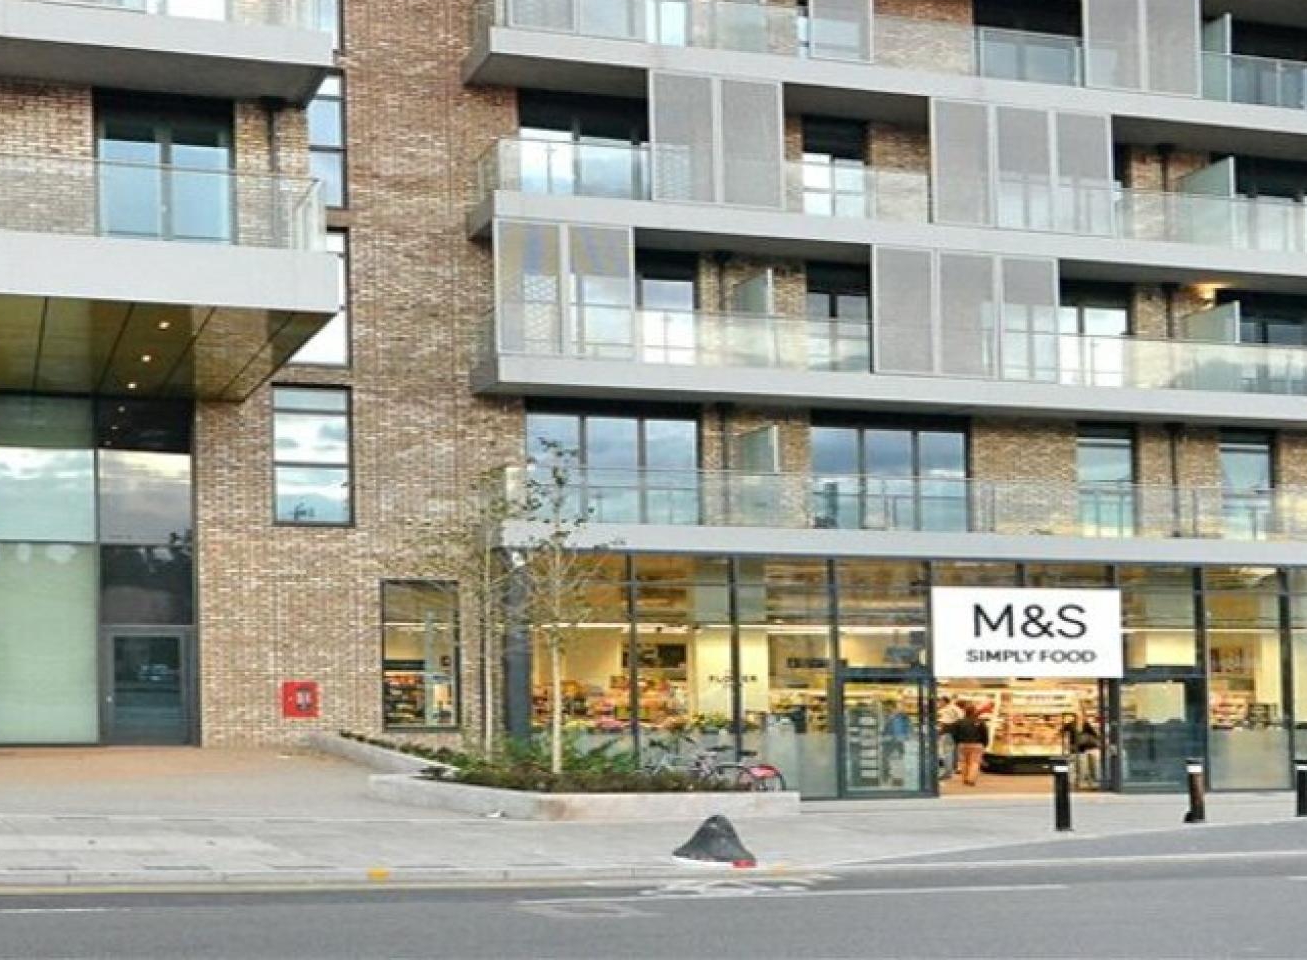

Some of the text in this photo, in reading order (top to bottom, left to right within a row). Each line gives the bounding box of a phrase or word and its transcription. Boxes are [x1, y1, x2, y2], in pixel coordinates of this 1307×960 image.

[973, 603, 1087, 639] M&S
[965, 649, 1097, 663] SIMPLY FOOD
